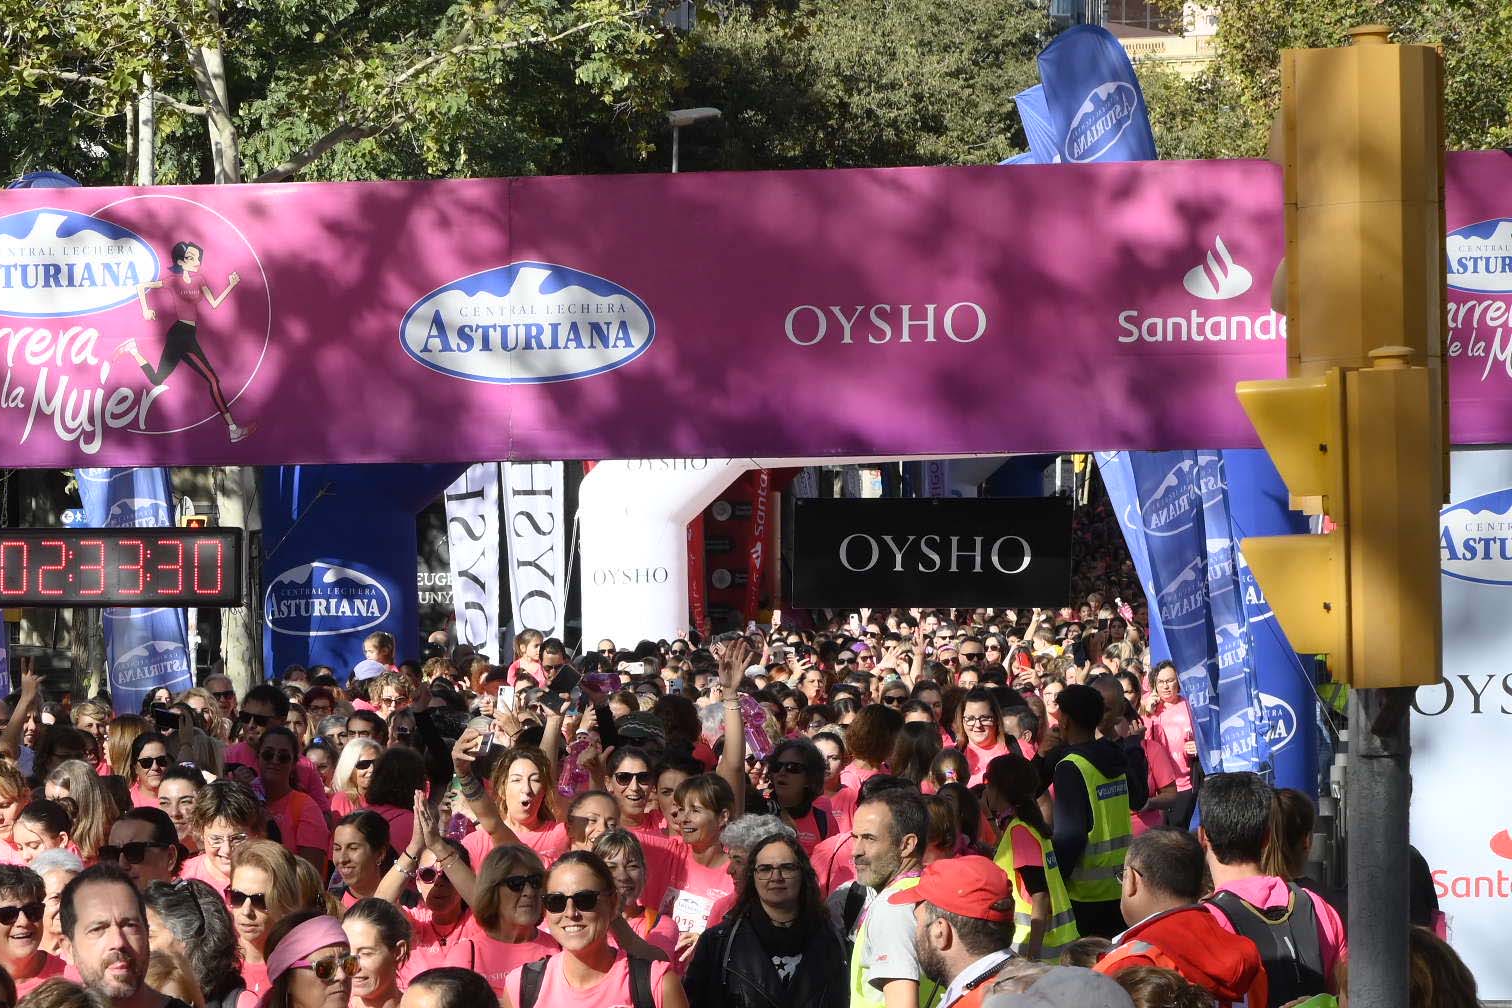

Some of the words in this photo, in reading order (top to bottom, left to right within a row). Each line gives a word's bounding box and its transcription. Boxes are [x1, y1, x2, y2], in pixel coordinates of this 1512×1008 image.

[63, 244, 134, 256] LECHERA
[420, 308, 635, 353] ASTURIANA
[460, 304, 538, 317] CENTRAL
[546, 302, 627, 314] LECHERA
[784, 302, 987, 346] OYSHO
[1, 368, 25, 408] la
[20, 361, 169, 455] Mujer
[0, 540, 223, 595] 02:33:30
[593, 566, 669, 585] OYSHO
[838, 532, 1032, 576] OYSHO
[268, 592, 381, 620] ASTURIANA
